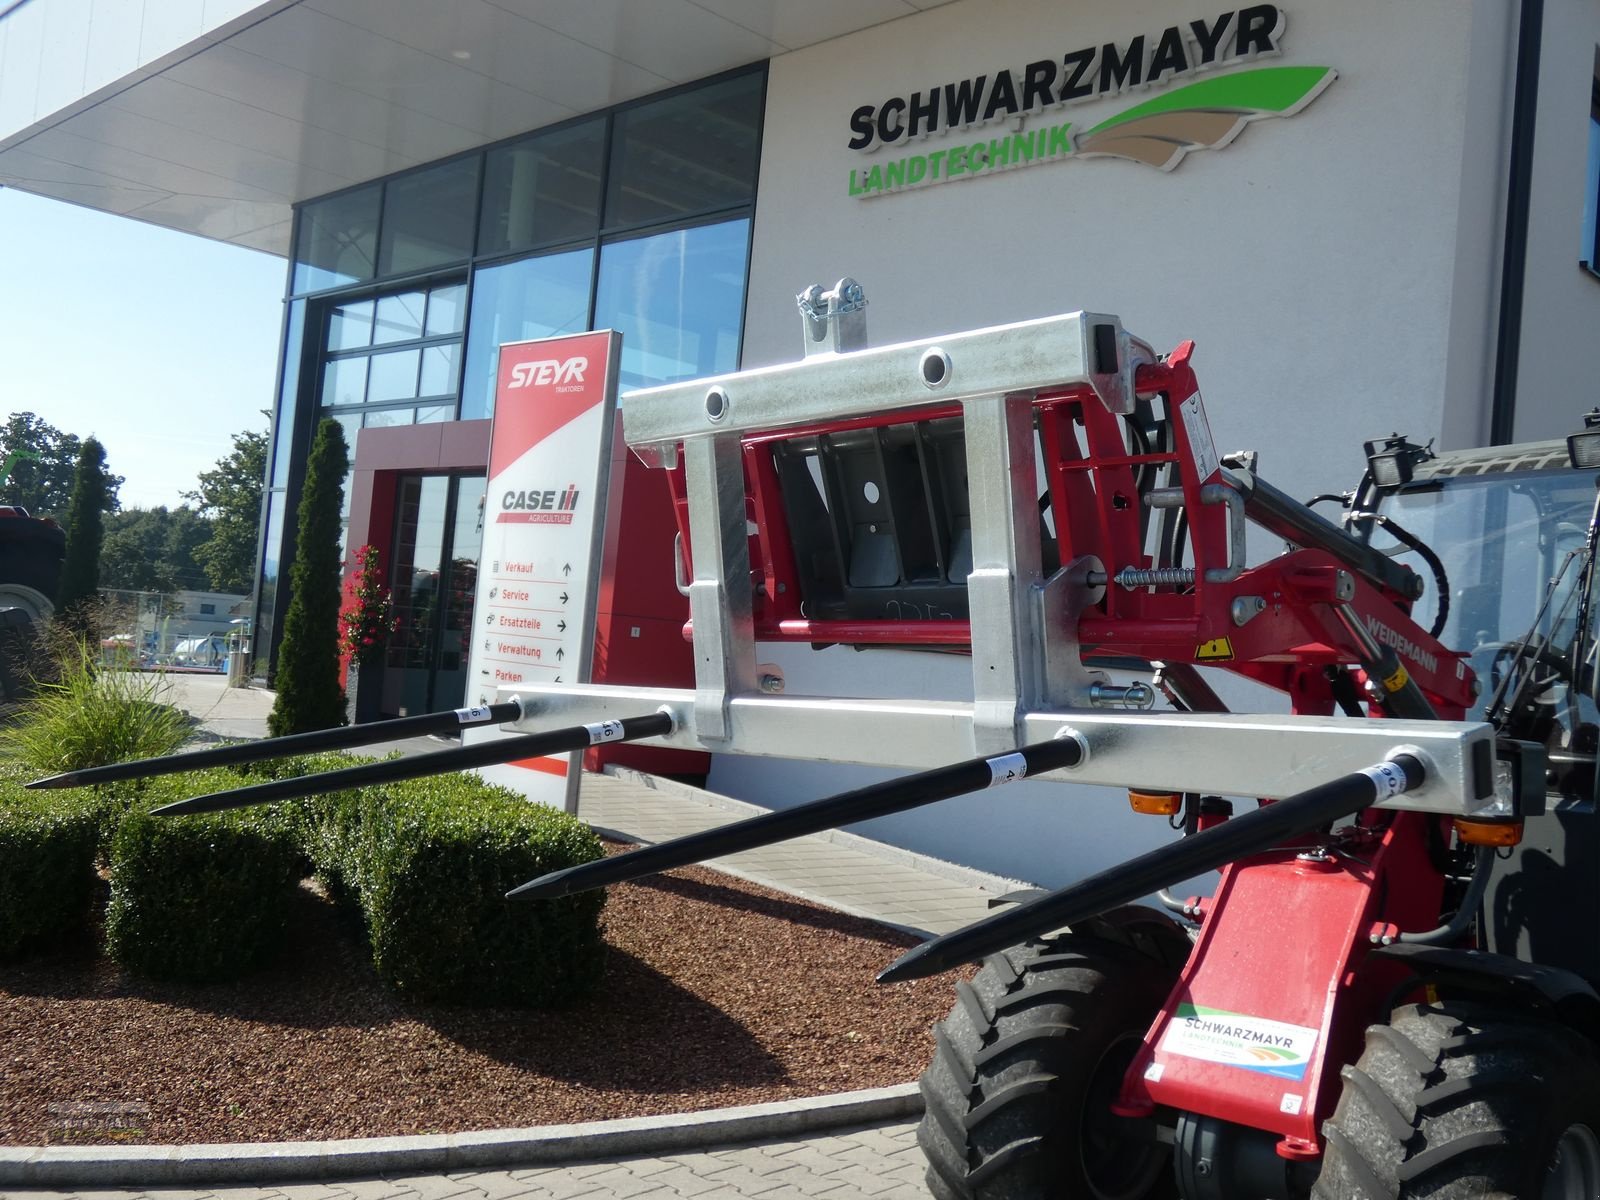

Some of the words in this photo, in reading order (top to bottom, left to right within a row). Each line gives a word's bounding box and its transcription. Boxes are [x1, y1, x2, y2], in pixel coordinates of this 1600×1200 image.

[848, 4, 1280, 151] SCHWARZMAYR
[848, 122, 1074, 197] LANDTECHNIK
[508, 357, 588, 389] STEYR
[555, 385, 585, 393] TRAKTOREN
[502, 490, 555, 511] CASE
[528, 513, 571, 523] AGRICULTURE
[505, 561, 533, 574] Verkauf
[502, 589, 529, 602] Service
[499, 614, 541, 630] Ersatzteile
[497, 642, 541, 658] Verwaltung
[1366, 614, 1438, 674] WEIDEMANN
[495, 669, 522, 682] Parken
[1182, 1031, 1244, 1049] LANDTECHNIK
[1184, 1017, 1294, 1049] SCHWARZMAYR
